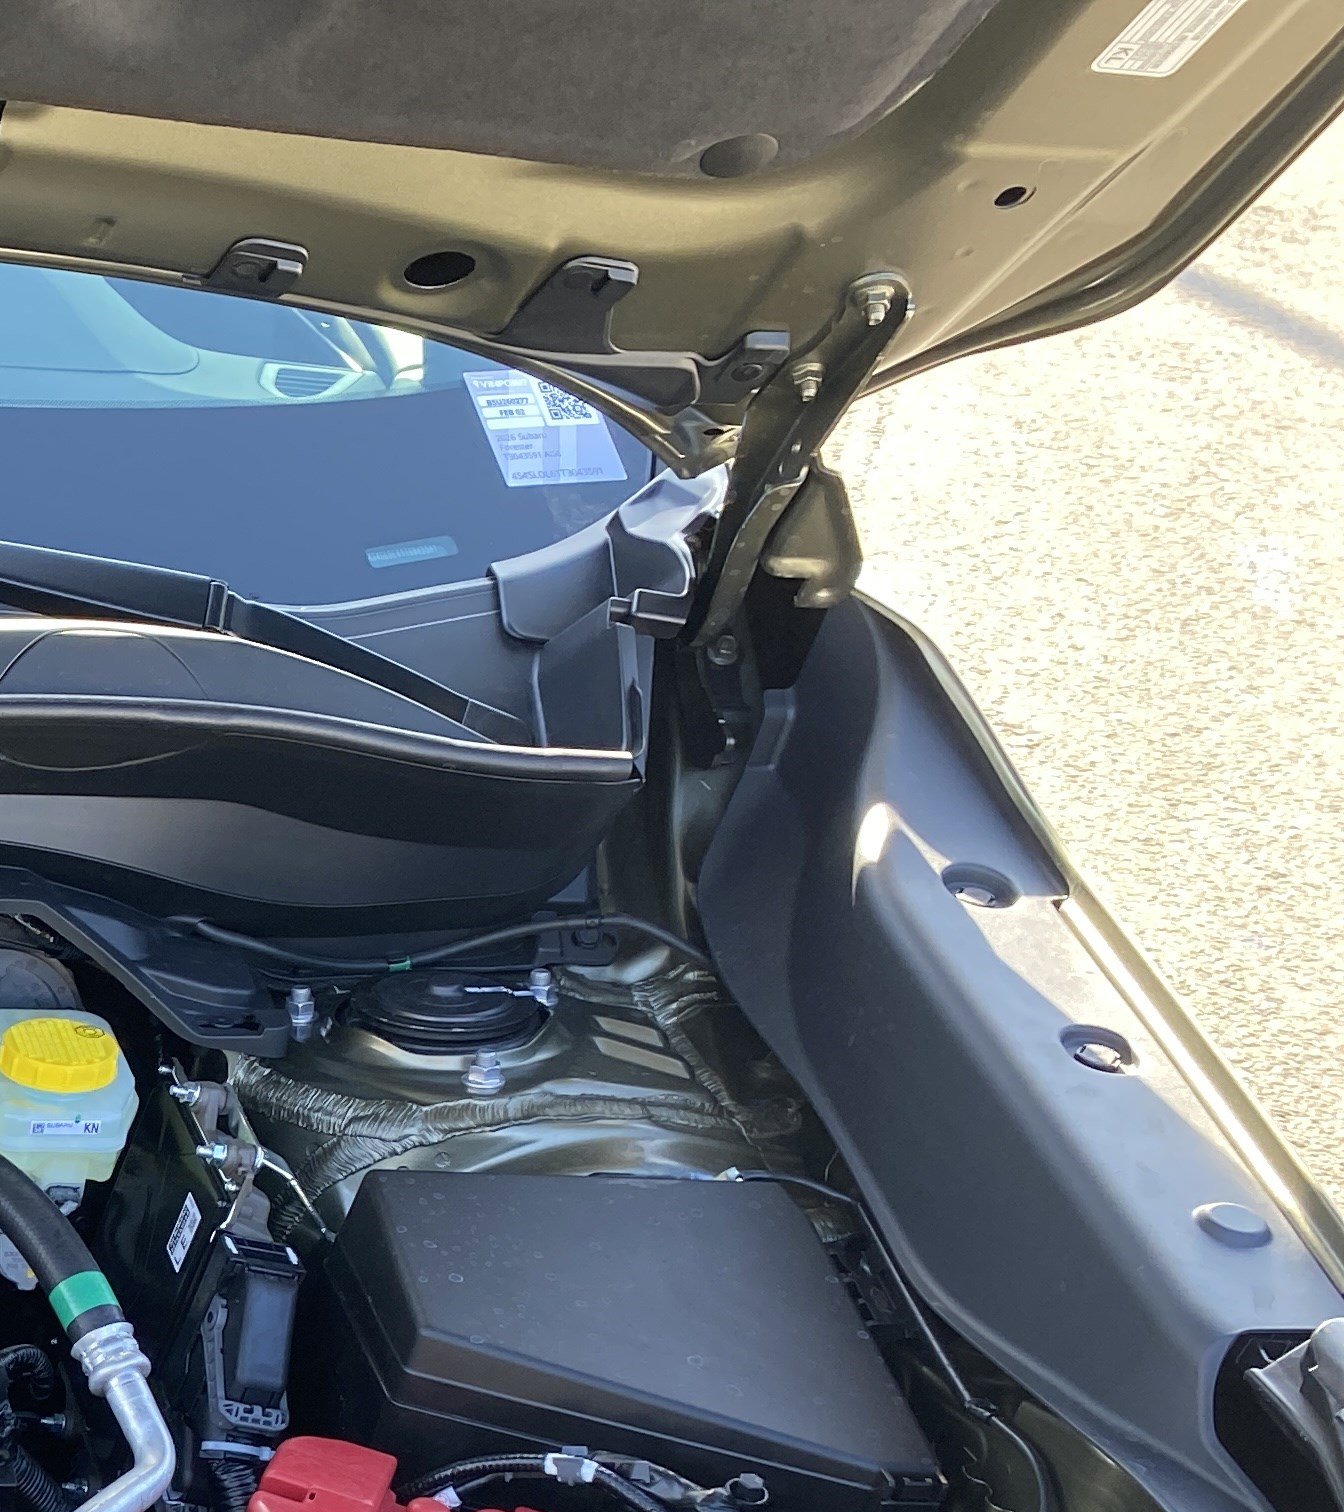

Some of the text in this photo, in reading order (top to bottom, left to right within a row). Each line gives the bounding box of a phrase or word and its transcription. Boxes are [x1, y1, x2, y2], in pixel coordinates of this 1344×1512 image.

[518, 431, 547, 440] Subaru
[500, 443, 533, 451] Forester
[83, 1122, 100, 1134] KN
